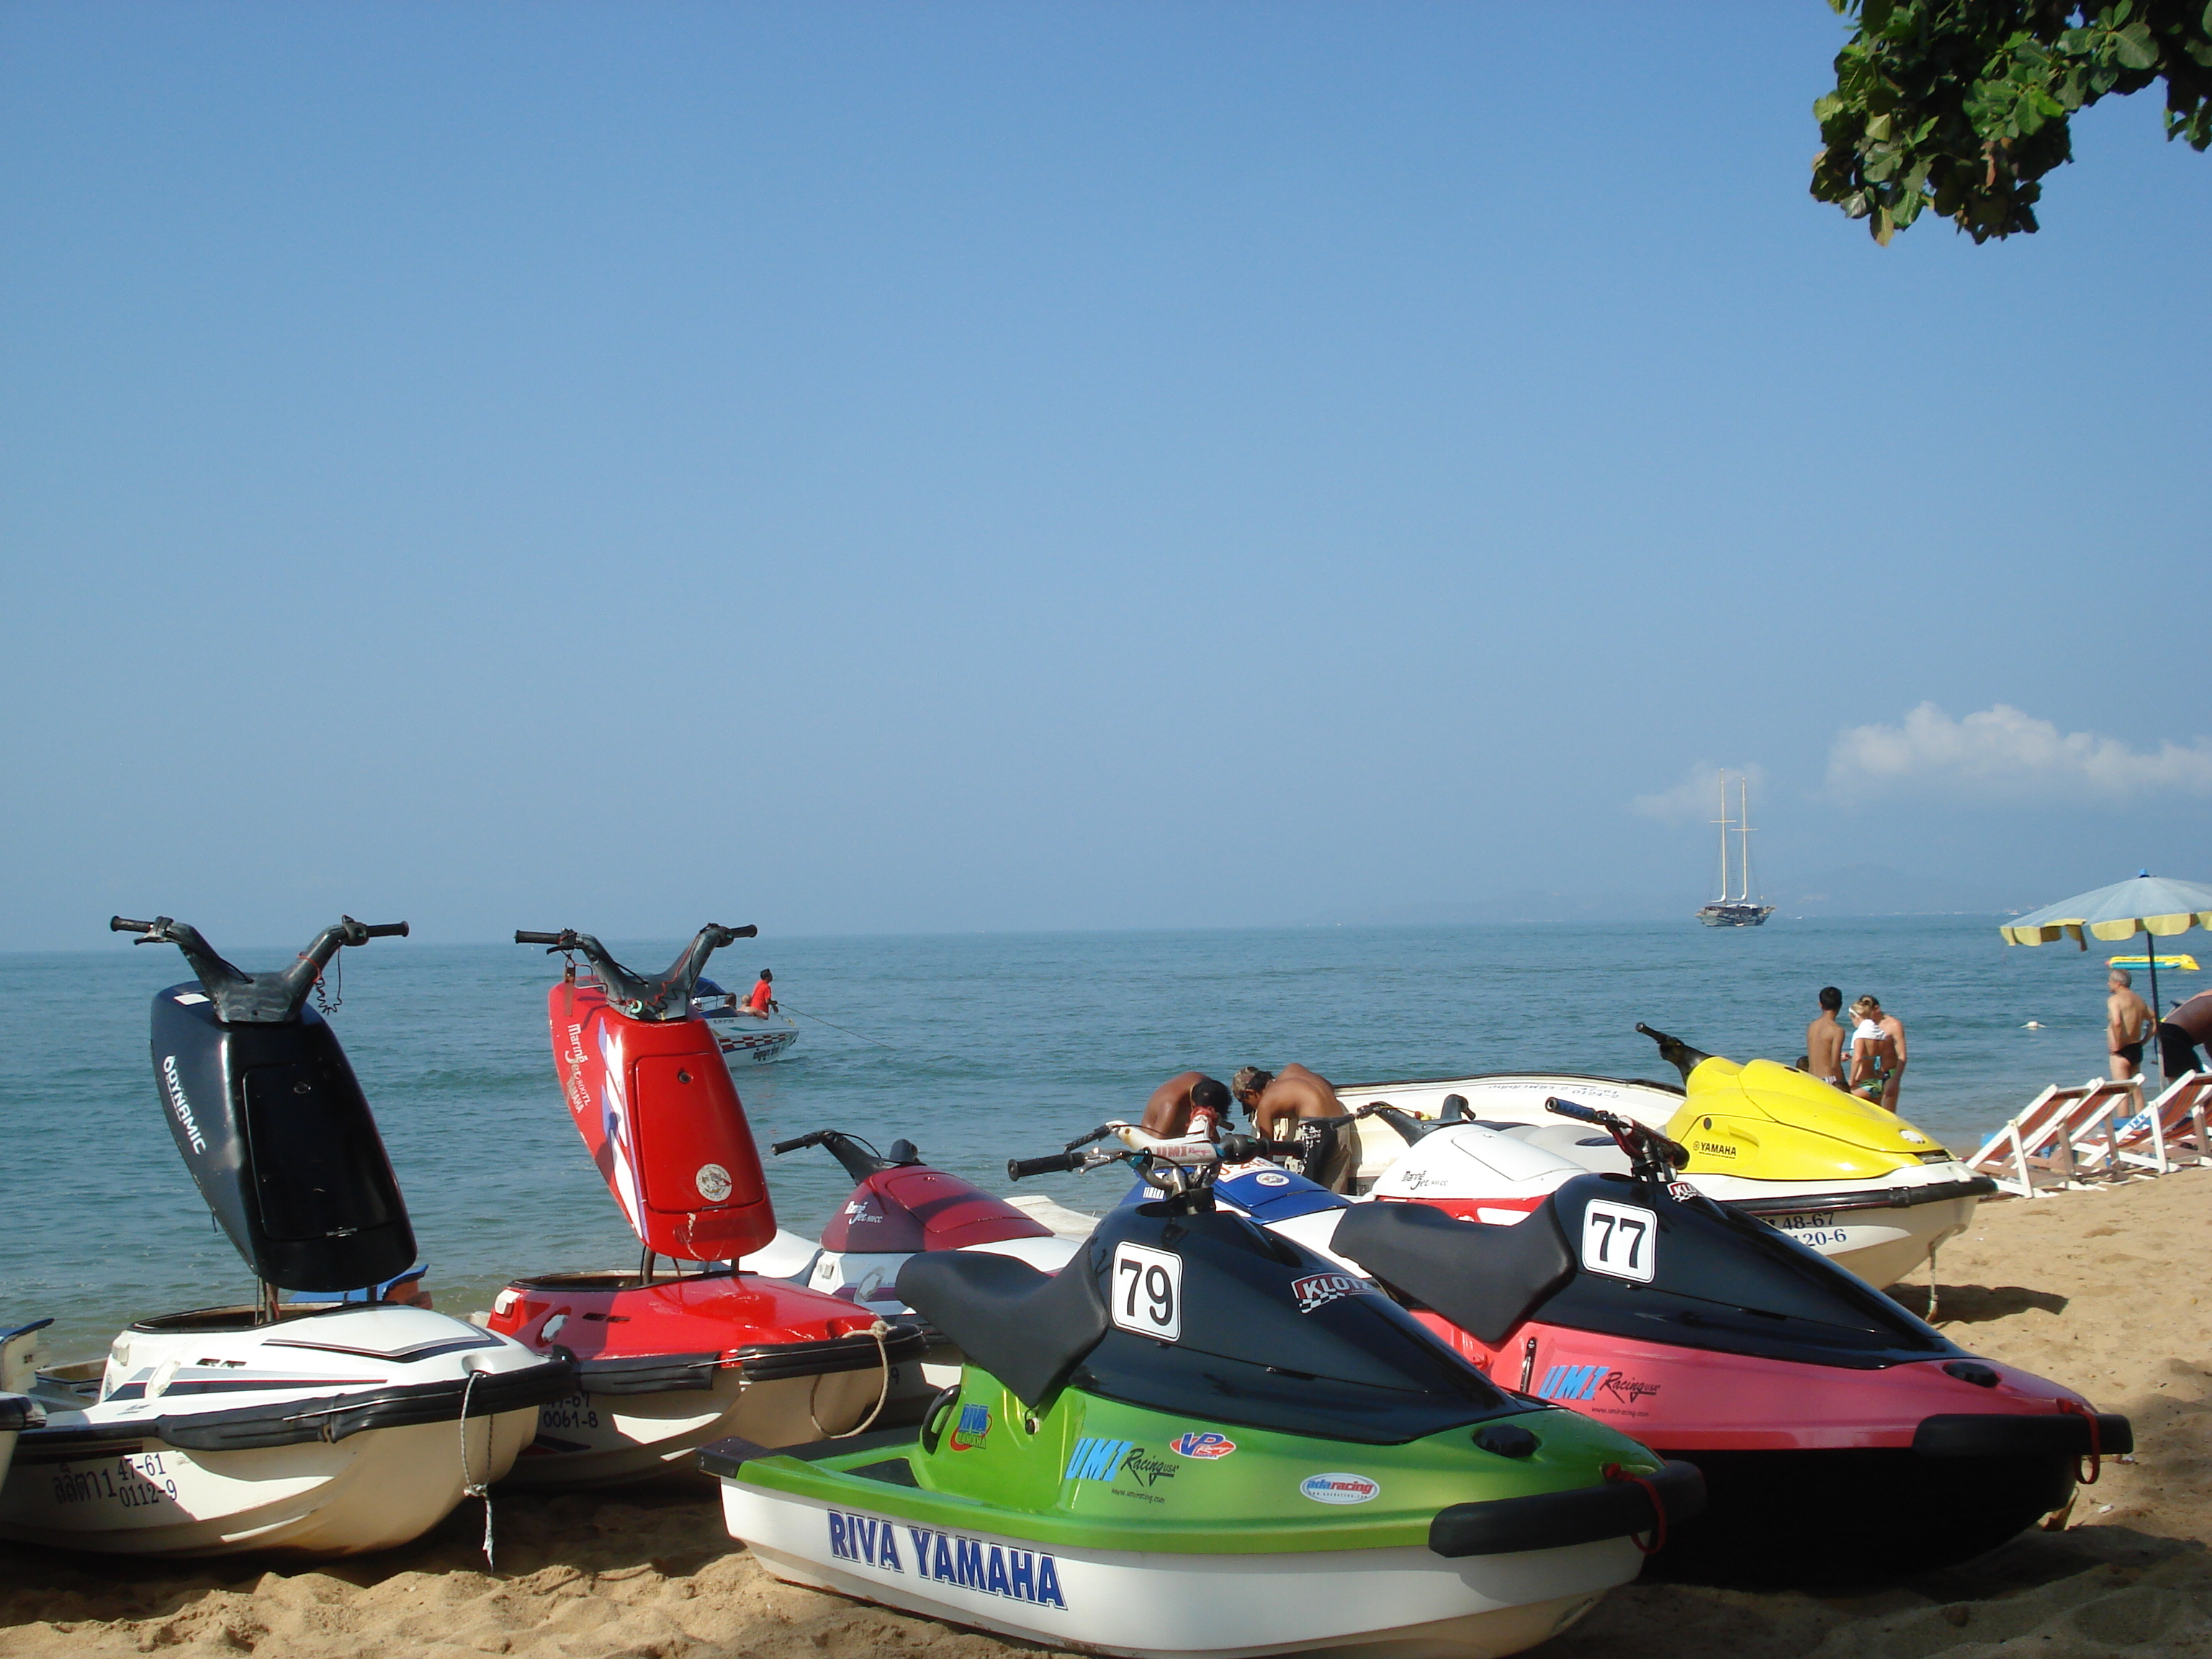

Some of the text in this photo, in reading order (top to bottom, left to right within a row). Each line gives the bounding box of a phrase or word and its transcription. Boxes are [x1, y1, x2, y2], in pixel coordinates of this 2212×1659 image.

[168, 1069, 207, 1156] DYNAMIC
[1700, 1141, 1737, 1156] YAMAHA
[1783, 1212, 1835, 1230] 48-67
[1591, 1212, 1647, 1269] 77
[1120, 1258, 1173, 1326] 79
[1599, 1371, 1649, 1403] Racing
[543, 1410, 598, 1428] 0061-8
[1178, 1433, 1226, 1456] VP
[118, 1453, 166, 1480] 47-61
[1120, 1448, 1174, 1487] Racing
[102, 1468, 117, 1498] 1
[120, 1479, 178, 1508] 0112-9
[1307, 1479, 1374, 1495] adaracing
[828, 1509, 1069, 1611] RIVA YAMAHA
